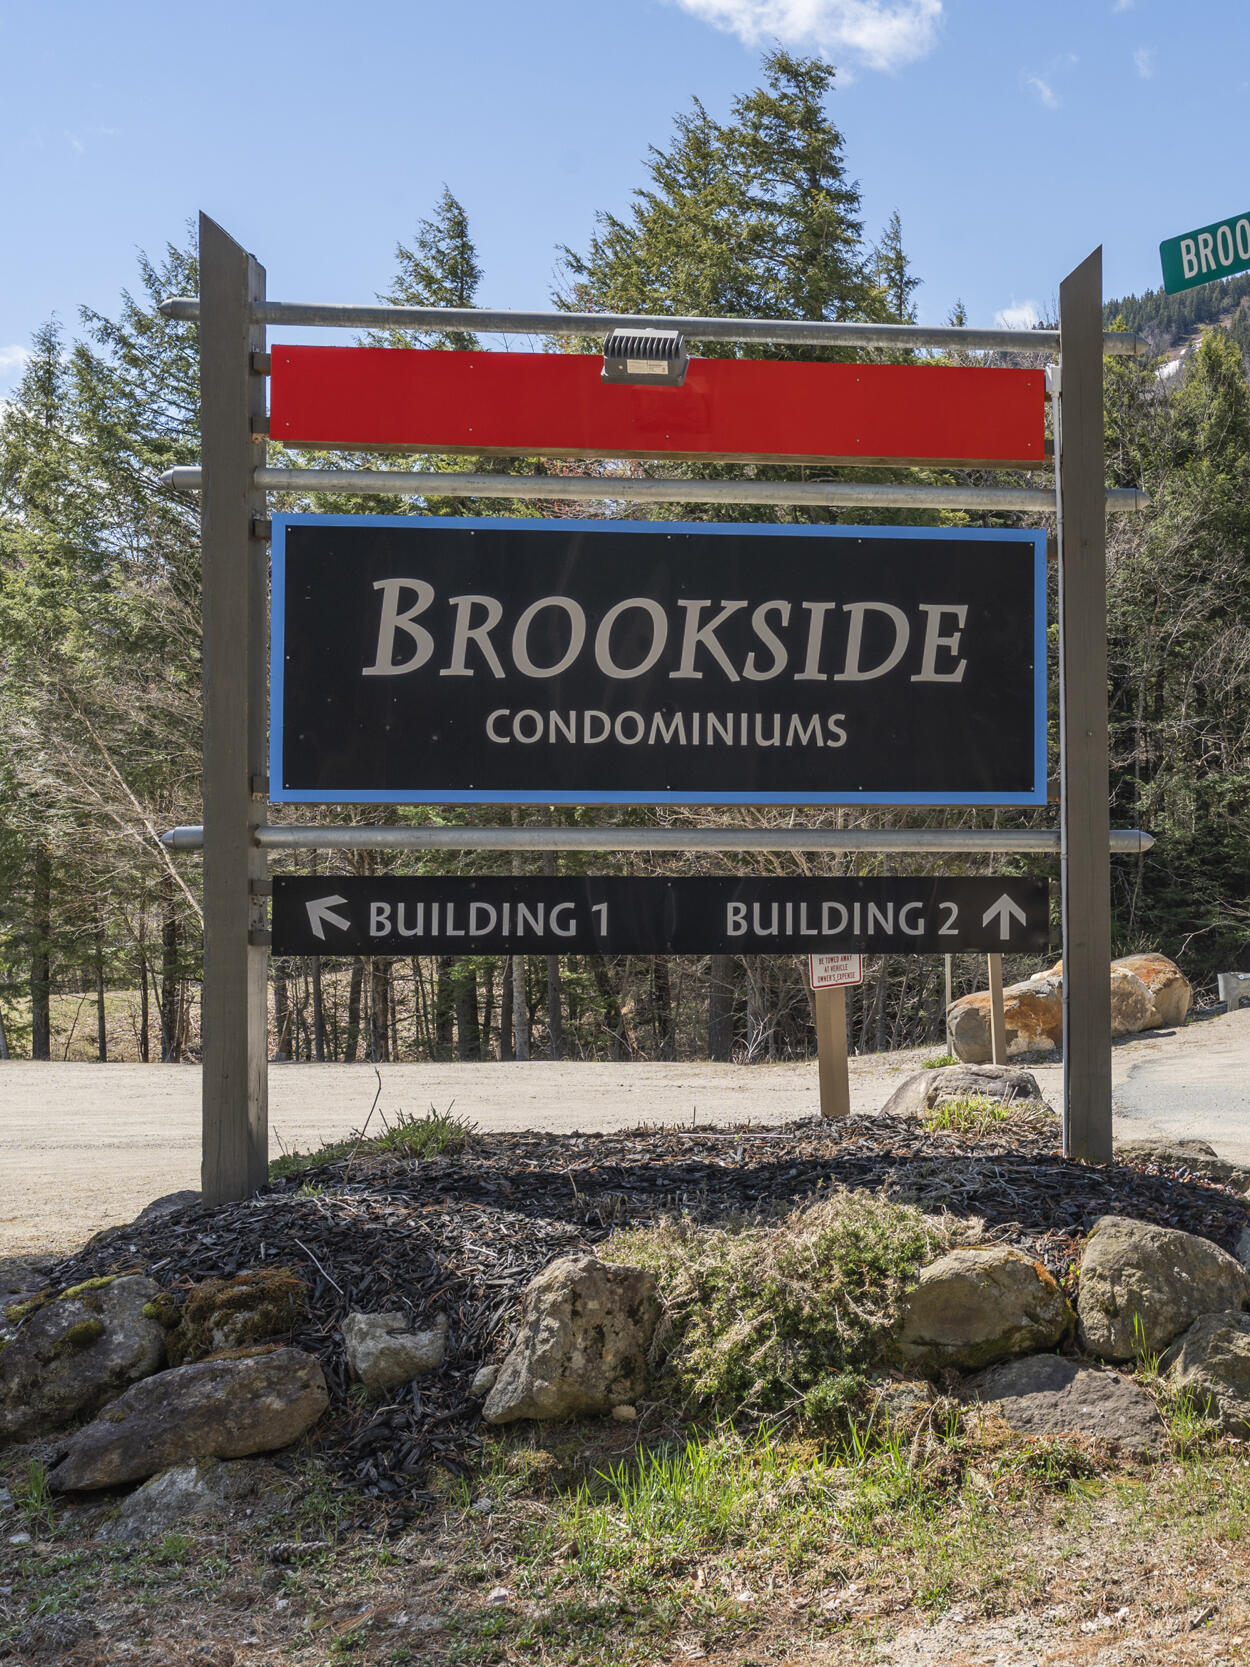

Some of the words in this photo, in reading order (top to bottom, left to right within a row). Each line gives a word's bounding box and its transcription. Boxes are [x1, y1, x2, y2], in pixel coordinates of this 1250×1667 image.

[362, 577, 968, 683] BROOKSIDE
[485, 709, 847, 748] CONDOMINIUMS
[369, 902, 577, 937] BUILDING
[591, 902, 609, 936] 1
[726, 901, 925, 936] BUILDING
[938, 901, 960, 935] 2
[818, 974, 836, 983] OWNER'S
[836, 972, 856, 980] EXPENSE
[824, 965, 829, 973] AT
[830, 964, 848, 972] VEHICLE
[825, 956, 839, 964] TOWED
